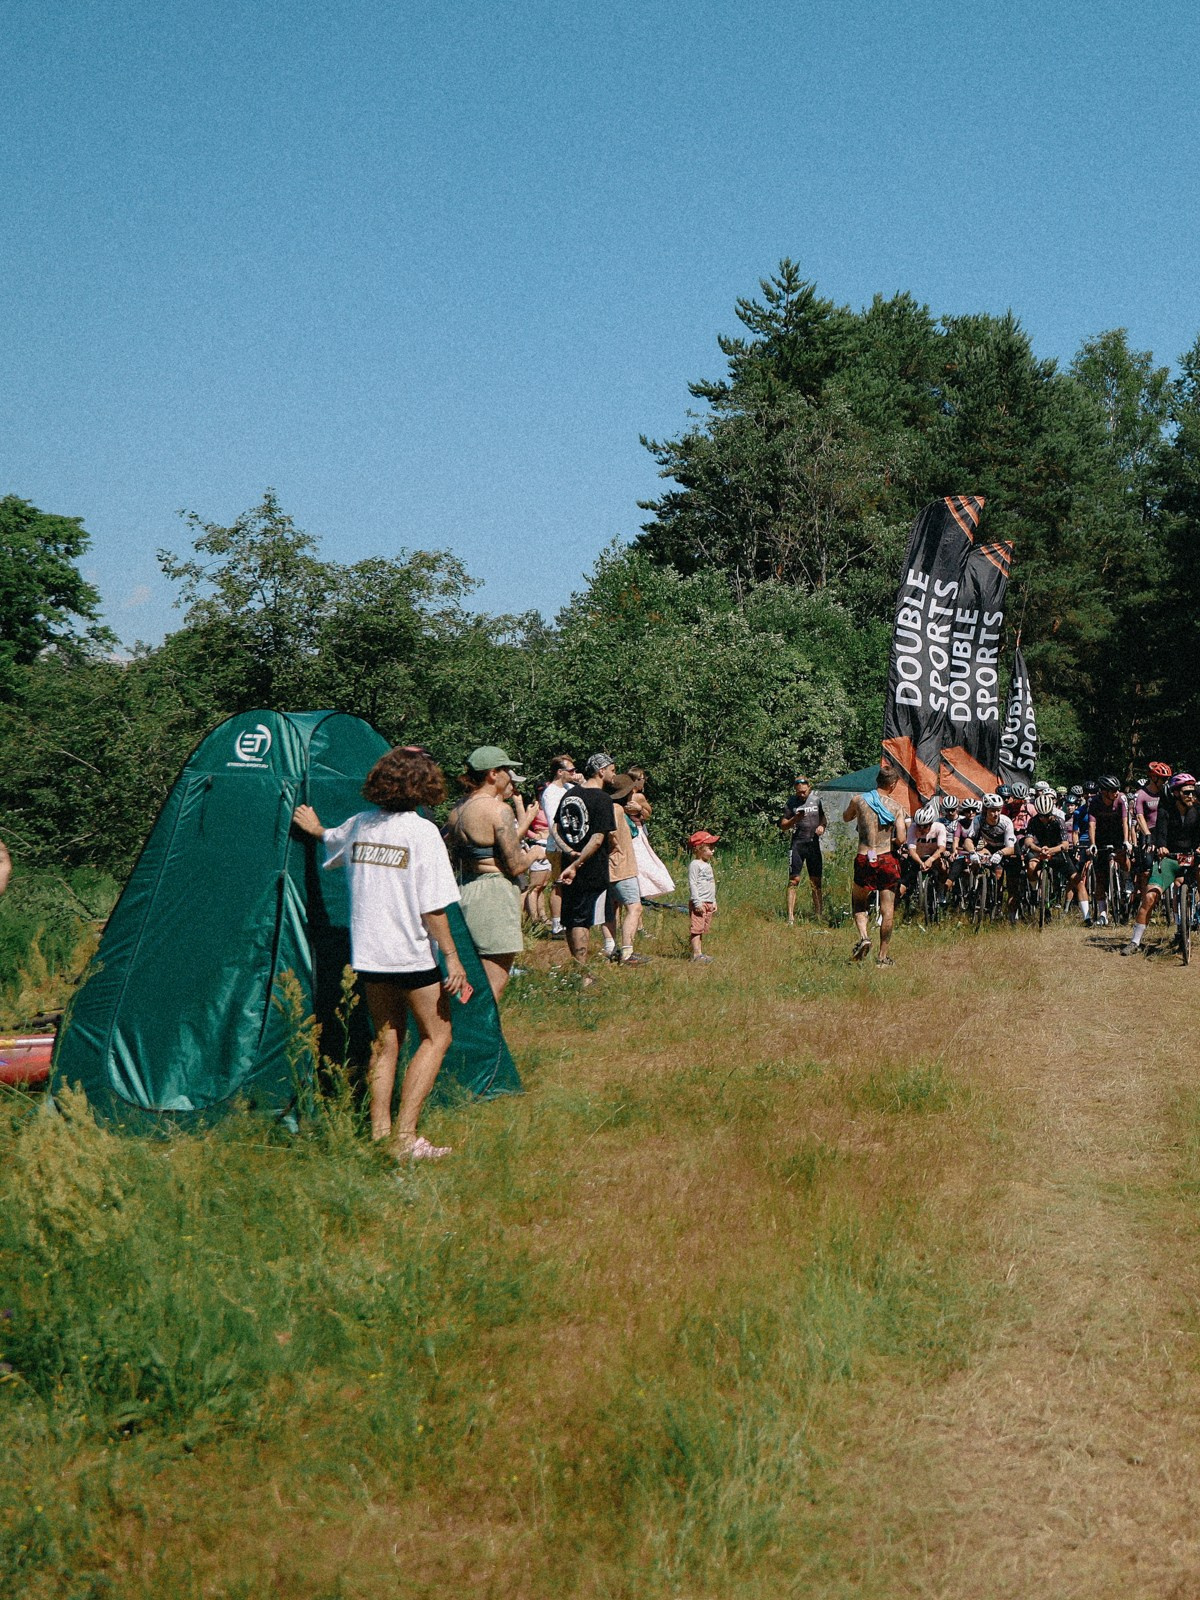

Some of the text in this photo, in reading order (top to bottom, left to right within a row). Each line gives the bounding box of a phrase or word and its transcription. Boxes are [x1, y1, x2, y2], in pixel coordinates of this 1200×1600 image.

[896, 569, 929, 706] DOUBLE
[927, 579, 958, 712] SPORTS
[949, 607, 979, 721] DOUBLE
[975, 611, 1004, 721] SPORTS
[1017, 678, 1037, 772] SPORT
